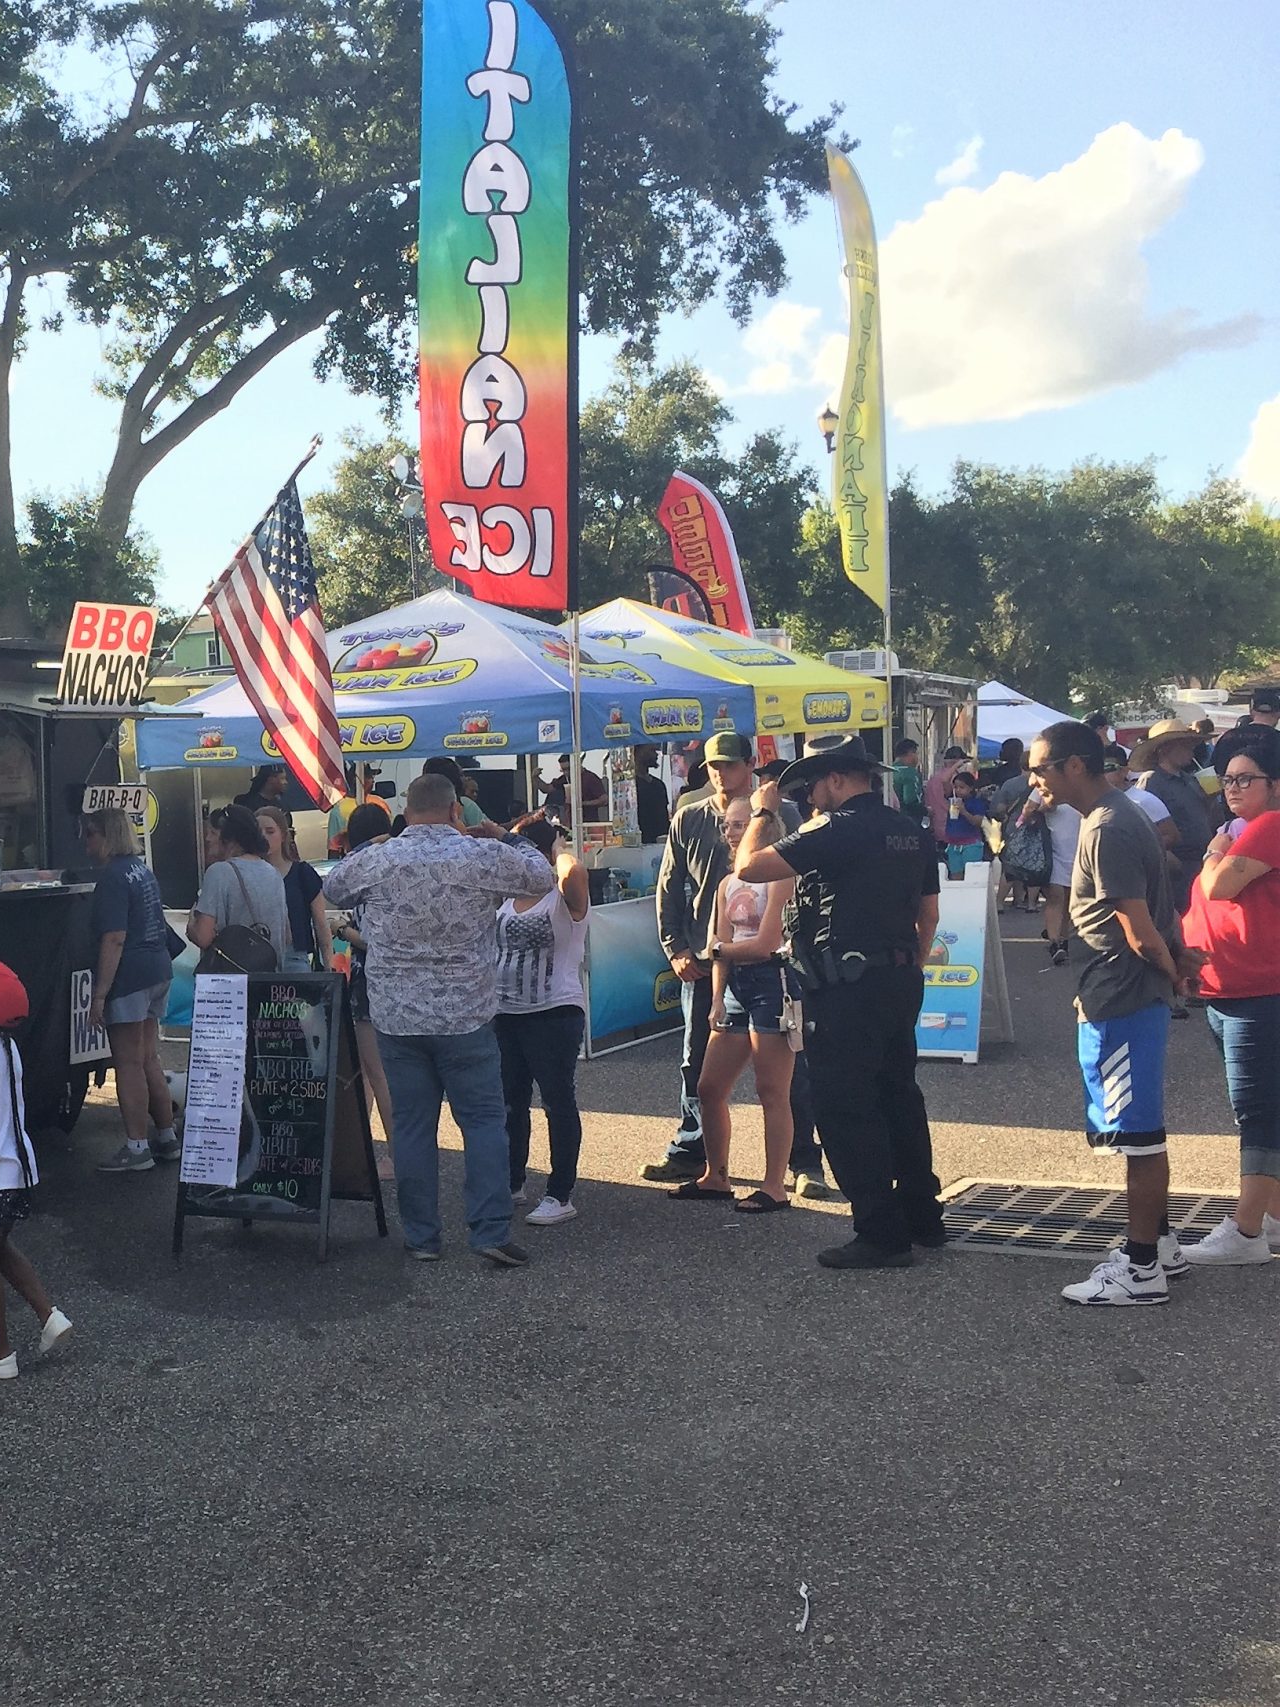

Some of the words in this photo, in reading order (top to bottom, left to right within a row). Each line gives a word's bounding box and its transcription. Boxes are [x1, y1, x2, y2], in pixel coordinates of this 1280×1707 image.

[70, 606, 154, 655] BBQ
[57, 652, 146, 707] NACHOS
[400, 664, 466, 686] ICE
[360, 722, 406, 745] ICE
[88, 789, 141, 810] BAR-B-Q
[73, 972, 90, 1009] IC
[260, 1002, 307, 1019] NACHOS
[277, 1179, 299, 1198] $10
